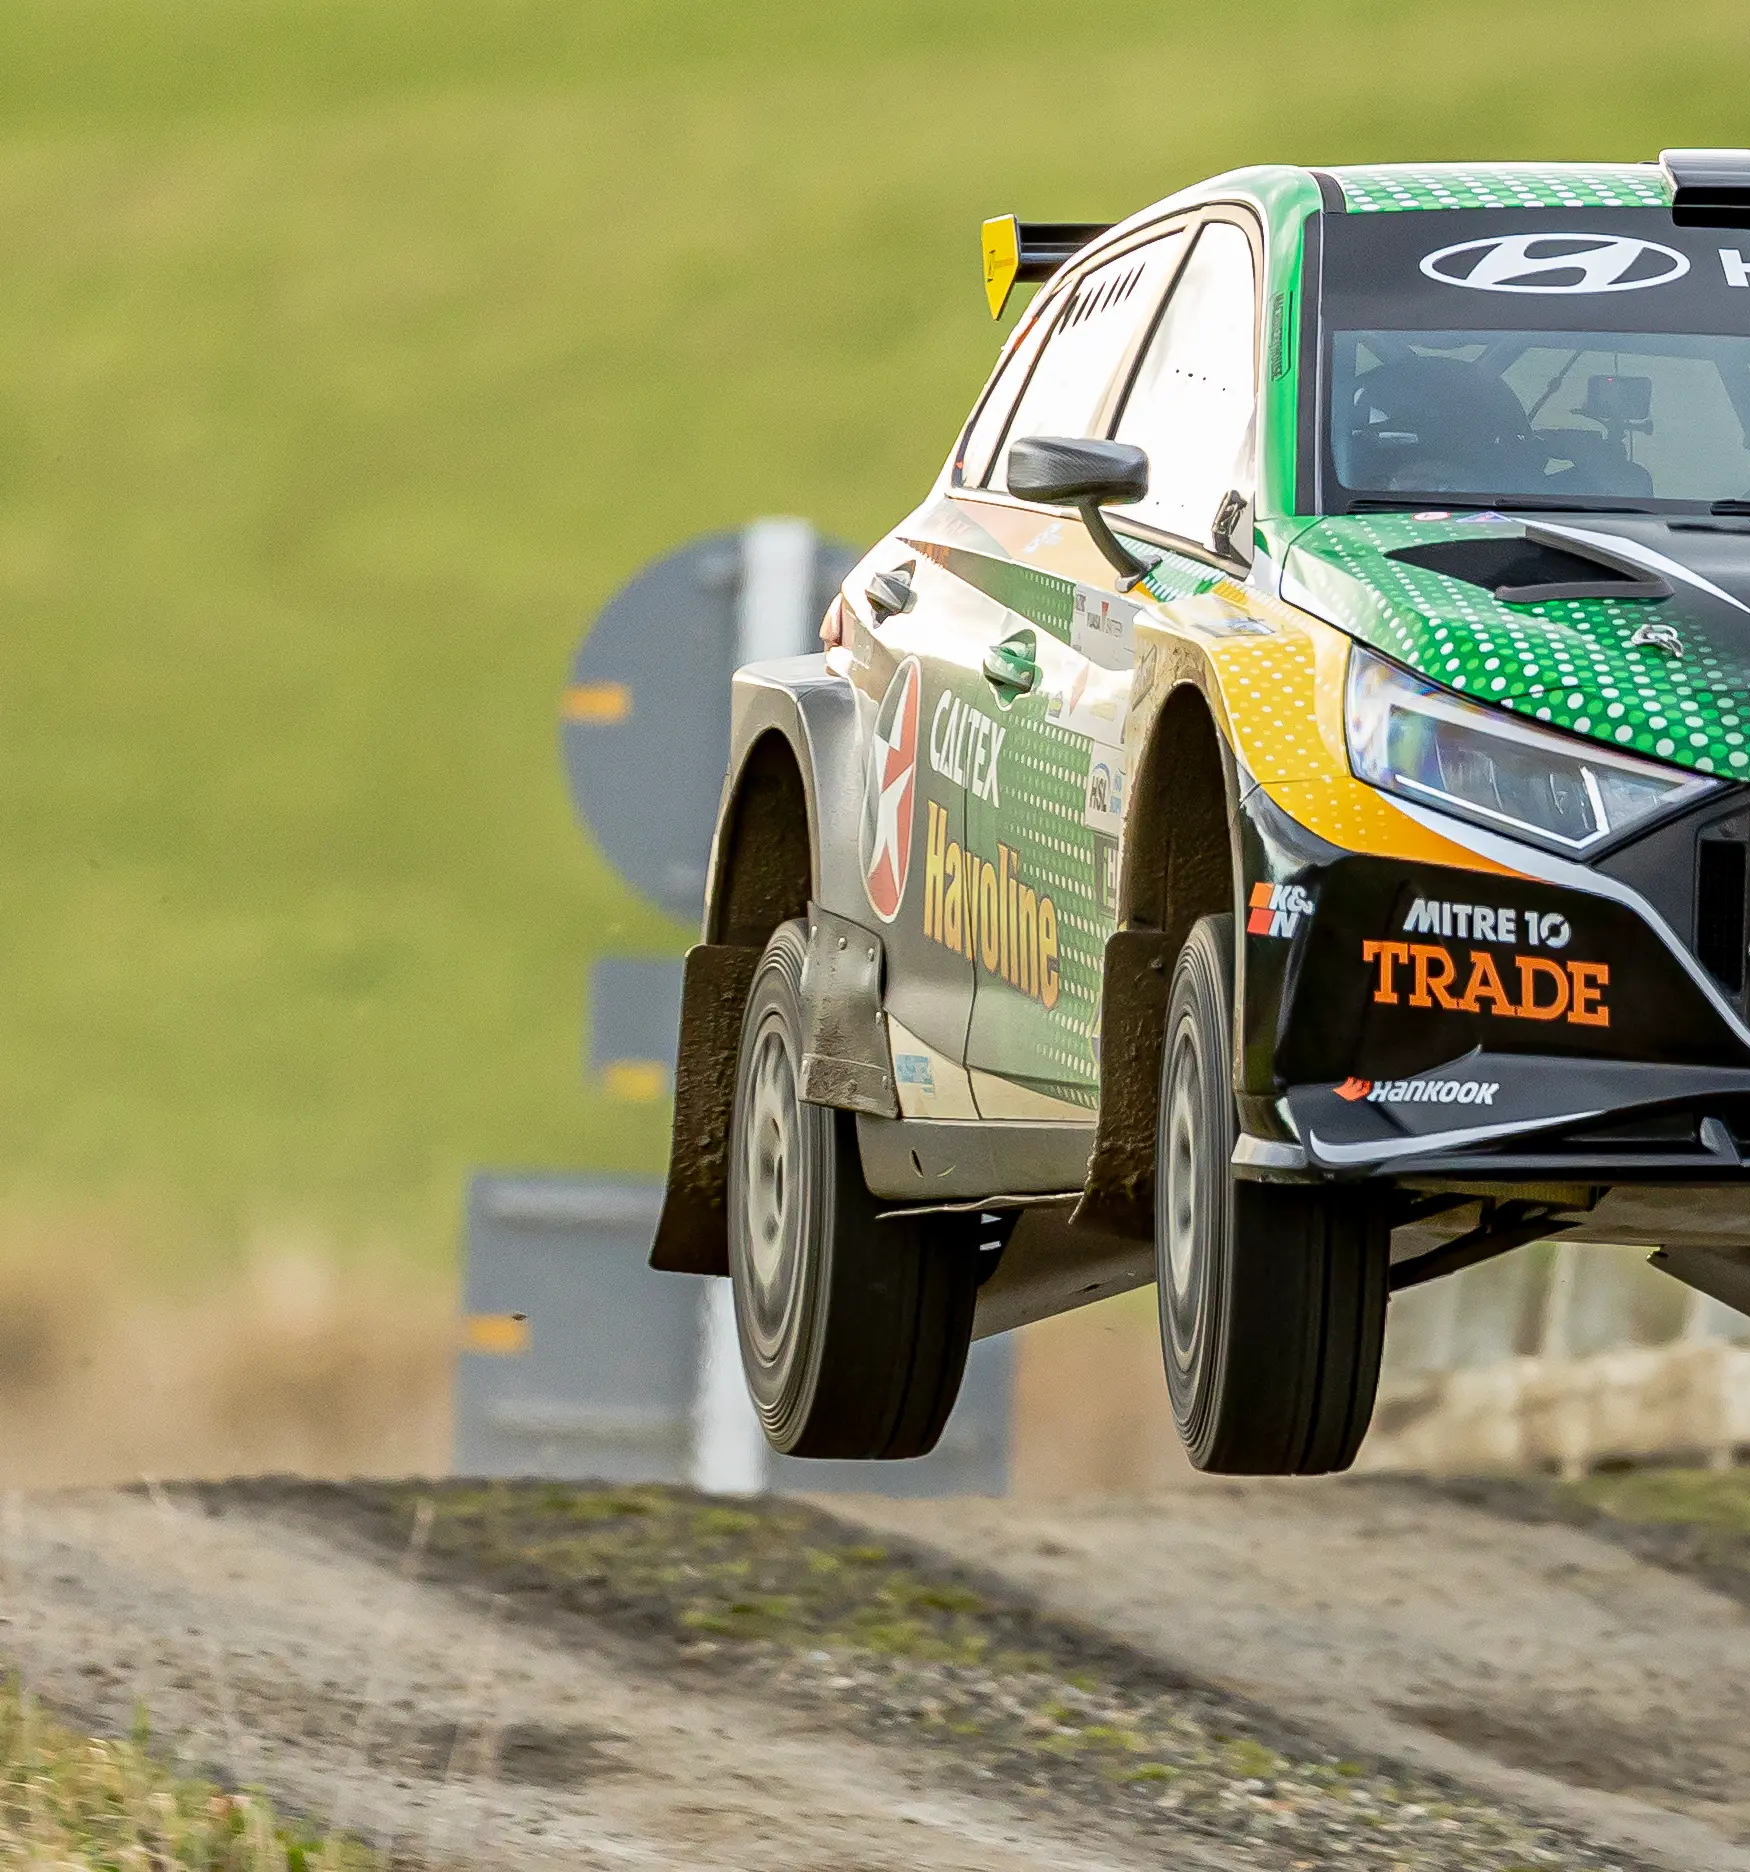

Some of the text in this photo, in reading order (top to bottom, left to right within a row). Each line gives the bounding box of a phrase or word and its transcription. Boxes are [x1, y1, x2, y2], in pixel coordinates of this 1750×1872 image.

[929, 688, 1007, 809] CALTEX
[923, 799, 1060, 1011] Havoline
[1402, 898, 1572, 949] MITRE 10
[1362, 940, 1611, 1027] TRADE
